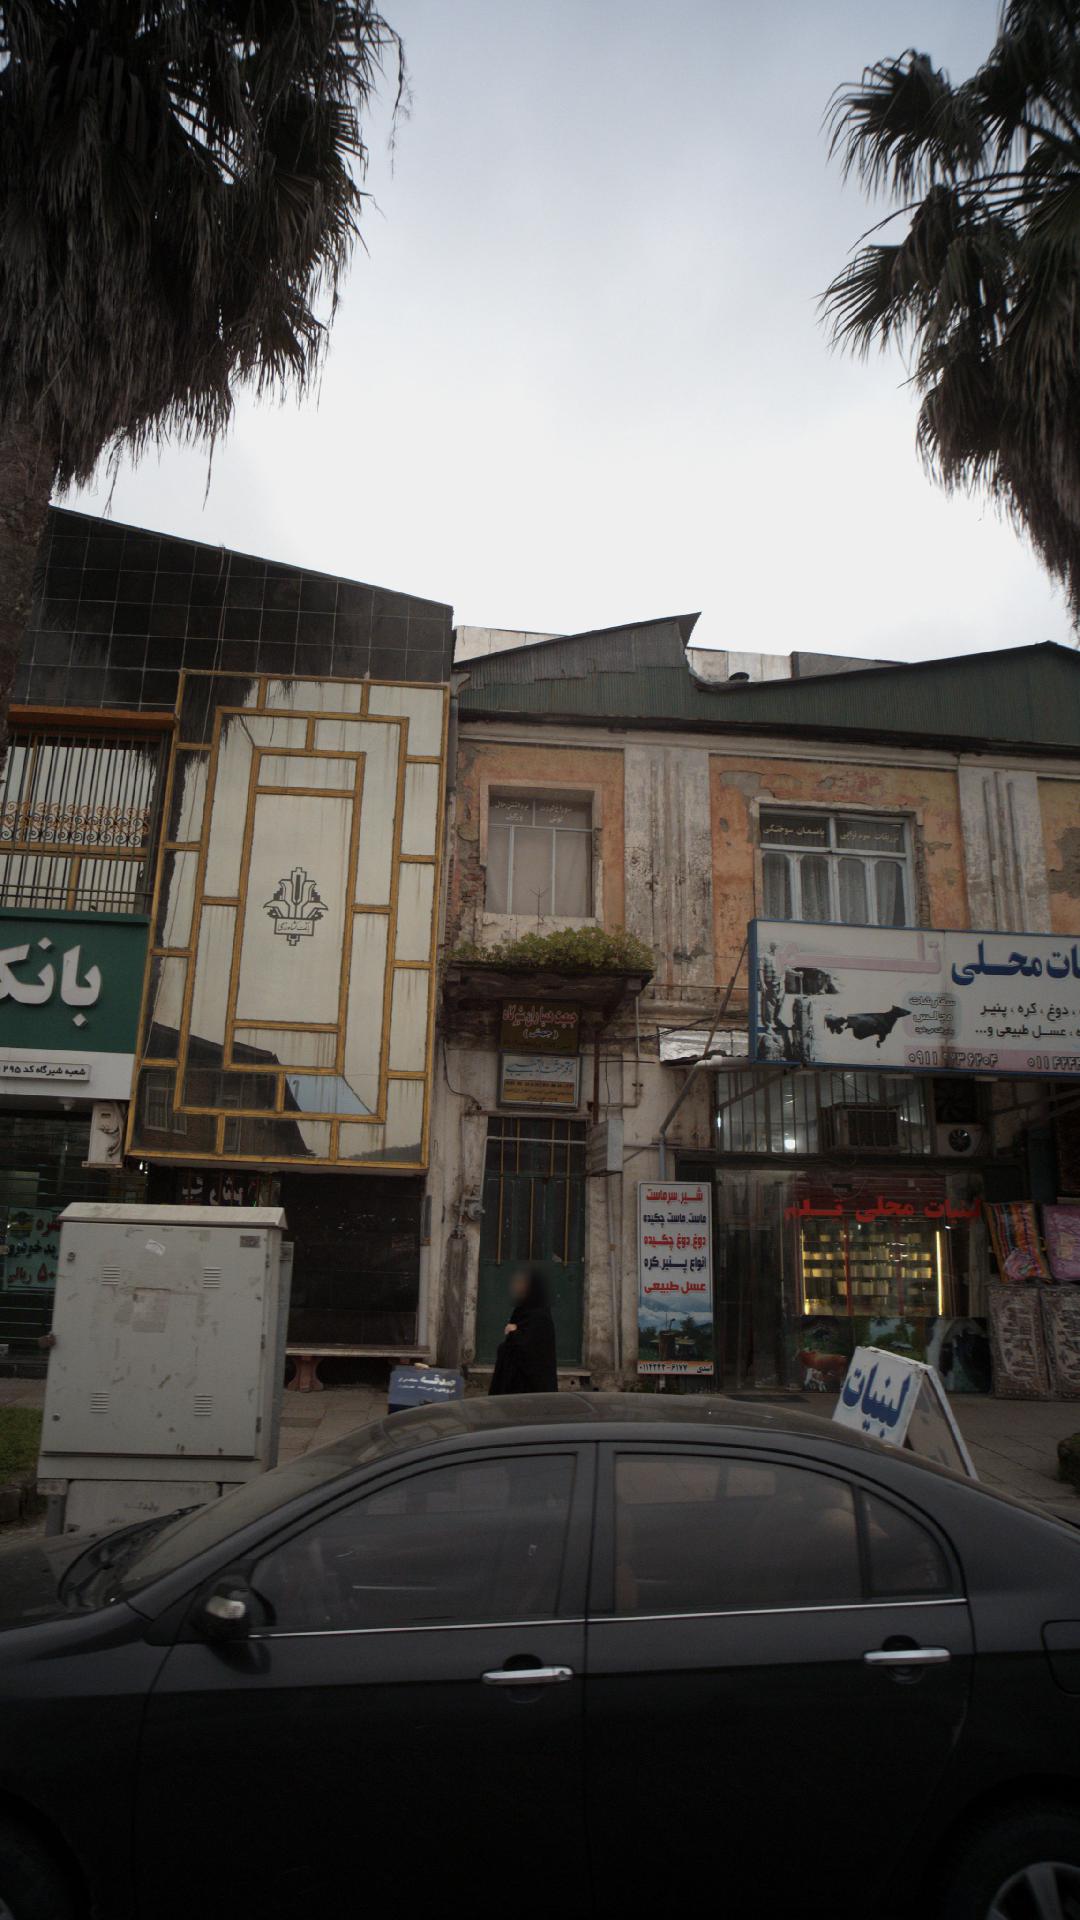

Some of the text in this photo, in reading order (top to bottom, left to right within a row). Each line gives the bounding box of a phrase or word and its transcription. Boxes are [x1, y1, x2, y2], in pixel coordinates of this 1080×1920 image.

[952, 940, 1042, 985] محلی
[981, 1003, 1008, 1018] پنیر
[997, 1024, 1029, 1038] طبیعی
[1031, 1025, 1067, 1039] عسل
[23, 1064, 35, 1074] کد
[36, 1065, 63, 1077] شیرگاه
[65, 1067, 87, 1078] شعبه
[856, 1194, 914, 1223] محلی
[643, 1212, 666, 1229] چکیده
[644, 1232, 706, 1252] دوغ دوغ چکیده
[643, 1255, 660, 1271] کره
[690, 1256, 707, 1272] انواع
[644, 1281, 706, 1295] عسل طبیعی
[842, 1362, 912, 1439] لبنیات
